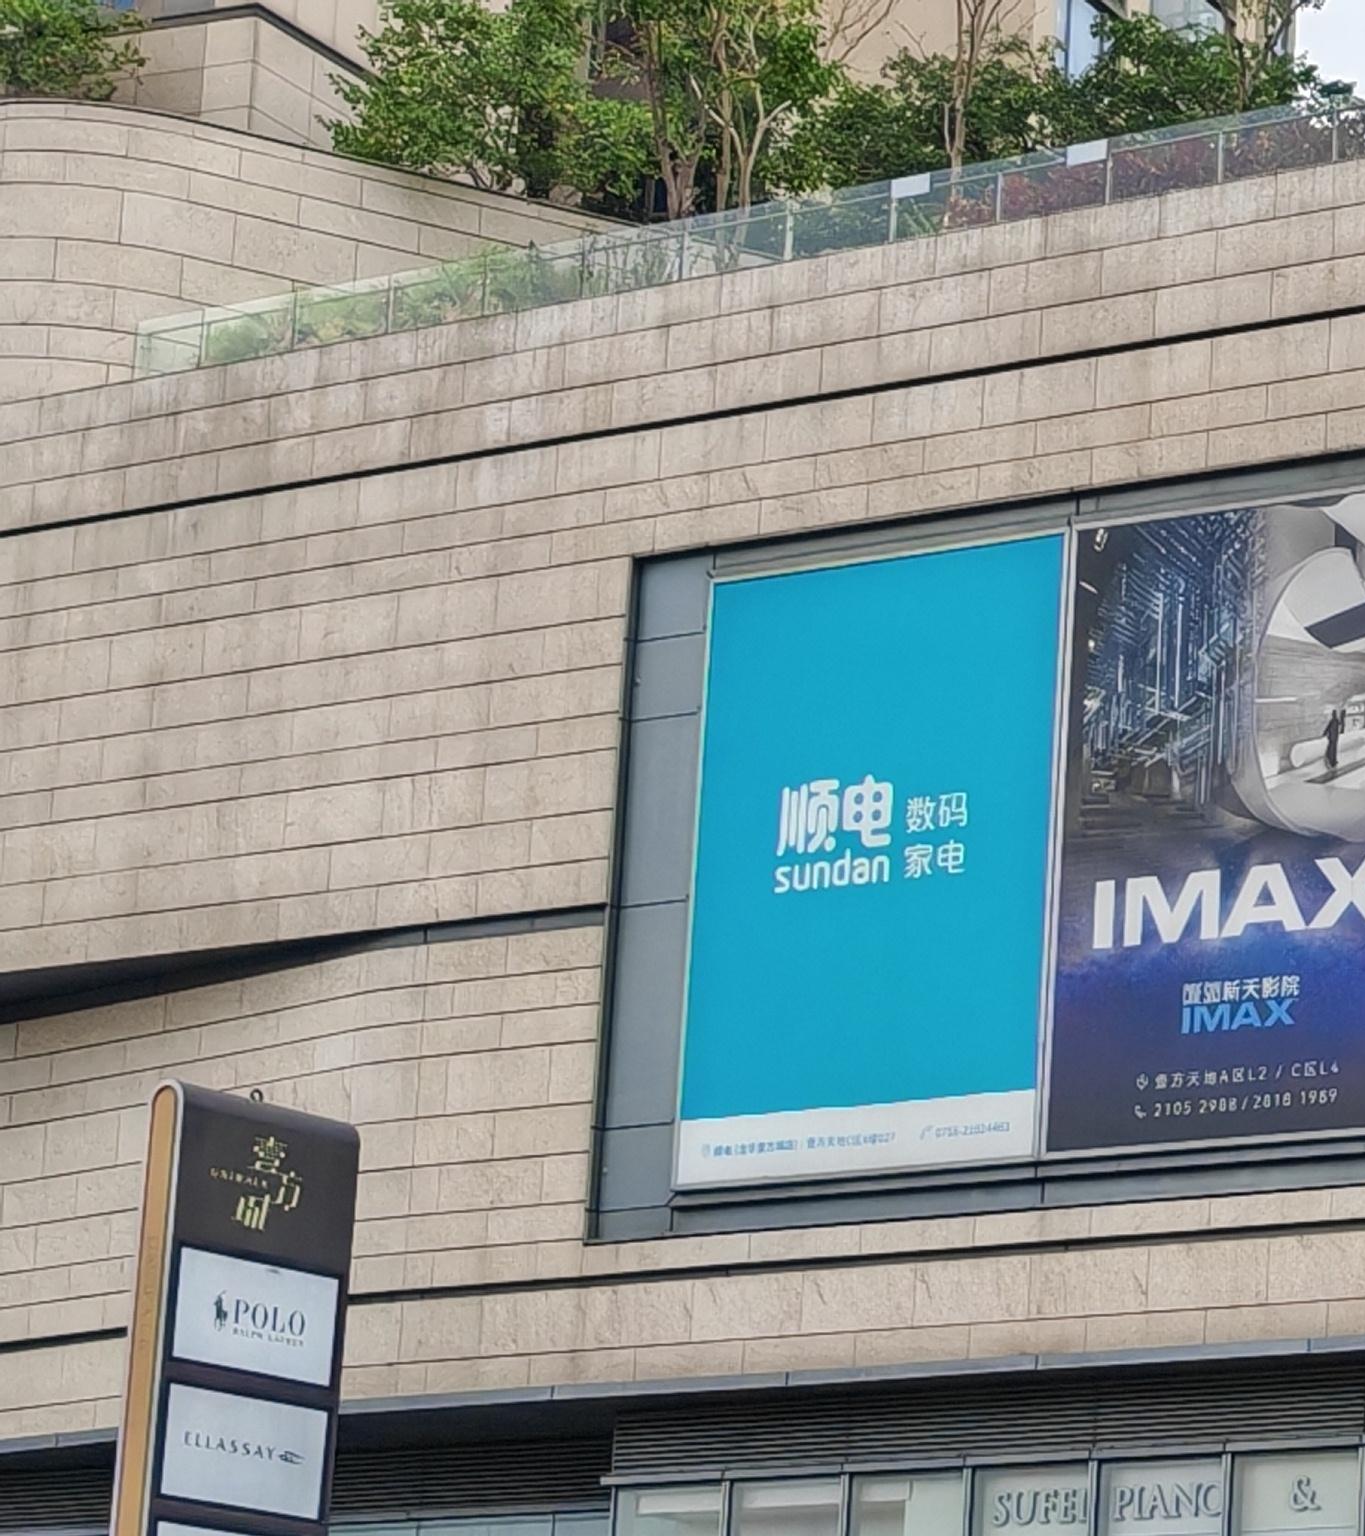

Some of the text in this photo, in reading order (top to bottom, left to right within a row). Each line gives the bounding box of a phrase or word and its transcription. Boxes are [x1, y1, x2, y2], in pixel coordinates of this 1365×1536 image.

[776, 773, 895, 858] 顺电
[906, 791, 970, 835] 数码
[773, 854, 892, 896] sundan
[902, 838, 967, 882] 家电
[1181, 999, 1296, 1035] IMAX
[234, 1298, 306, 1337] POLO
[184, 1430, 278, 1462] ELLASSAY
[992, 1486, 1089, 1528] SUFEI
[1289, 1474, 1322, 1513] &
